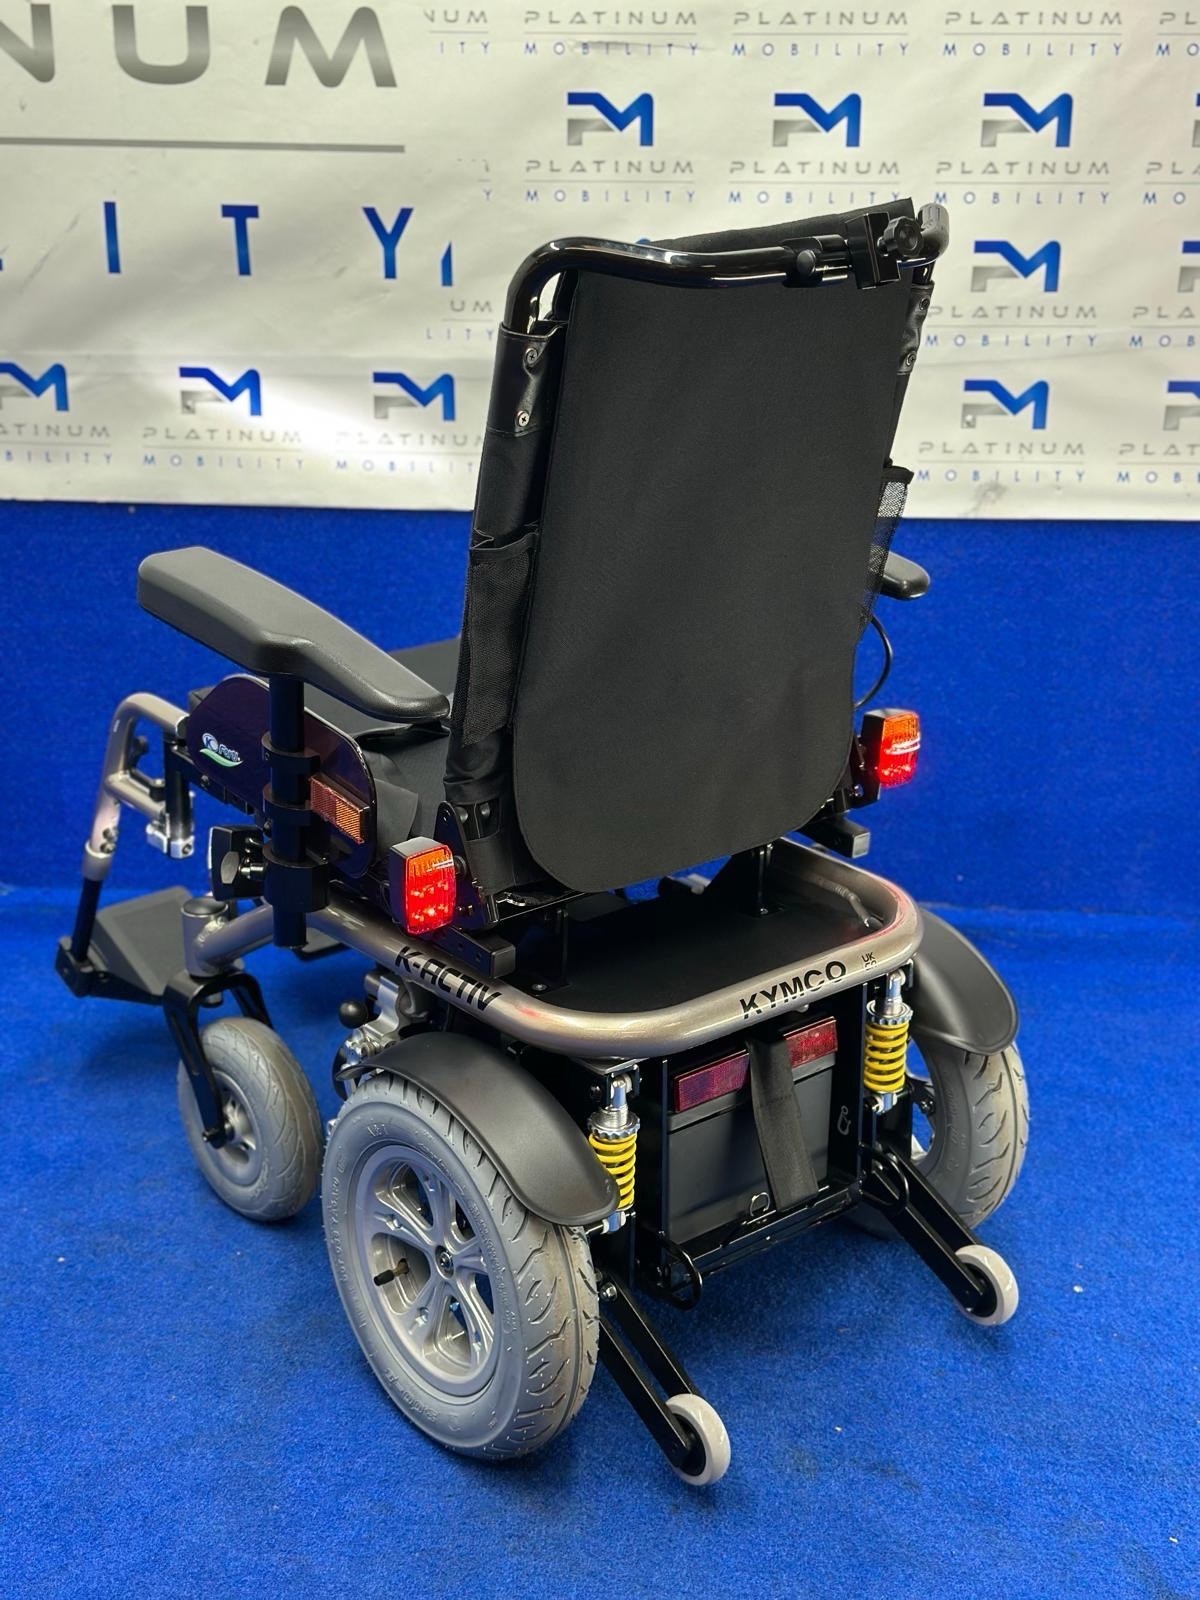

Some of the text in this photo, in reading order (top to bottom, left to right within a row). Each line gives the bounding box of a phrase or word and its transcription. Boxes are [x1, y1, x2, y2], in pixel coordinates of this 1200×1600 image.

[524, 11, 697, 25] PLATINUM
[733, 11, 908, 25] PLATINUM
[945, 12, 1122, 25] PLATINUM
[524, 42, 698, 55] MOBILITY
[732, 43, 909, 56] MOBILITY
[944, 43, 1123, 56] MOBILITY
[525, 160, 693, 173] PLATINUM
[729, 161, 899, 174] PLATINUM
[936, 161, 1109, 174] PLATINUM
[527, 190, 695, 202] MOBILITY
[729, 191, 900, 204] MOBILITY
[934, 192, 1109, 205] MOBILITY
[927, 305, 1096, 318] PLATINUM
[925, 334, 1097, 347] MOBILITY
[143, 427, 302, 442] PLATINUM
[919, 442, 1084, 456] PLATINUM
[143, 454, 304, 468] MOBILITY
[917, 470, 1086, 483] MOBILITY
[395, 946, 503, 1012] K-ACTIV
[740, 961, 847, 1020] KYMCO
